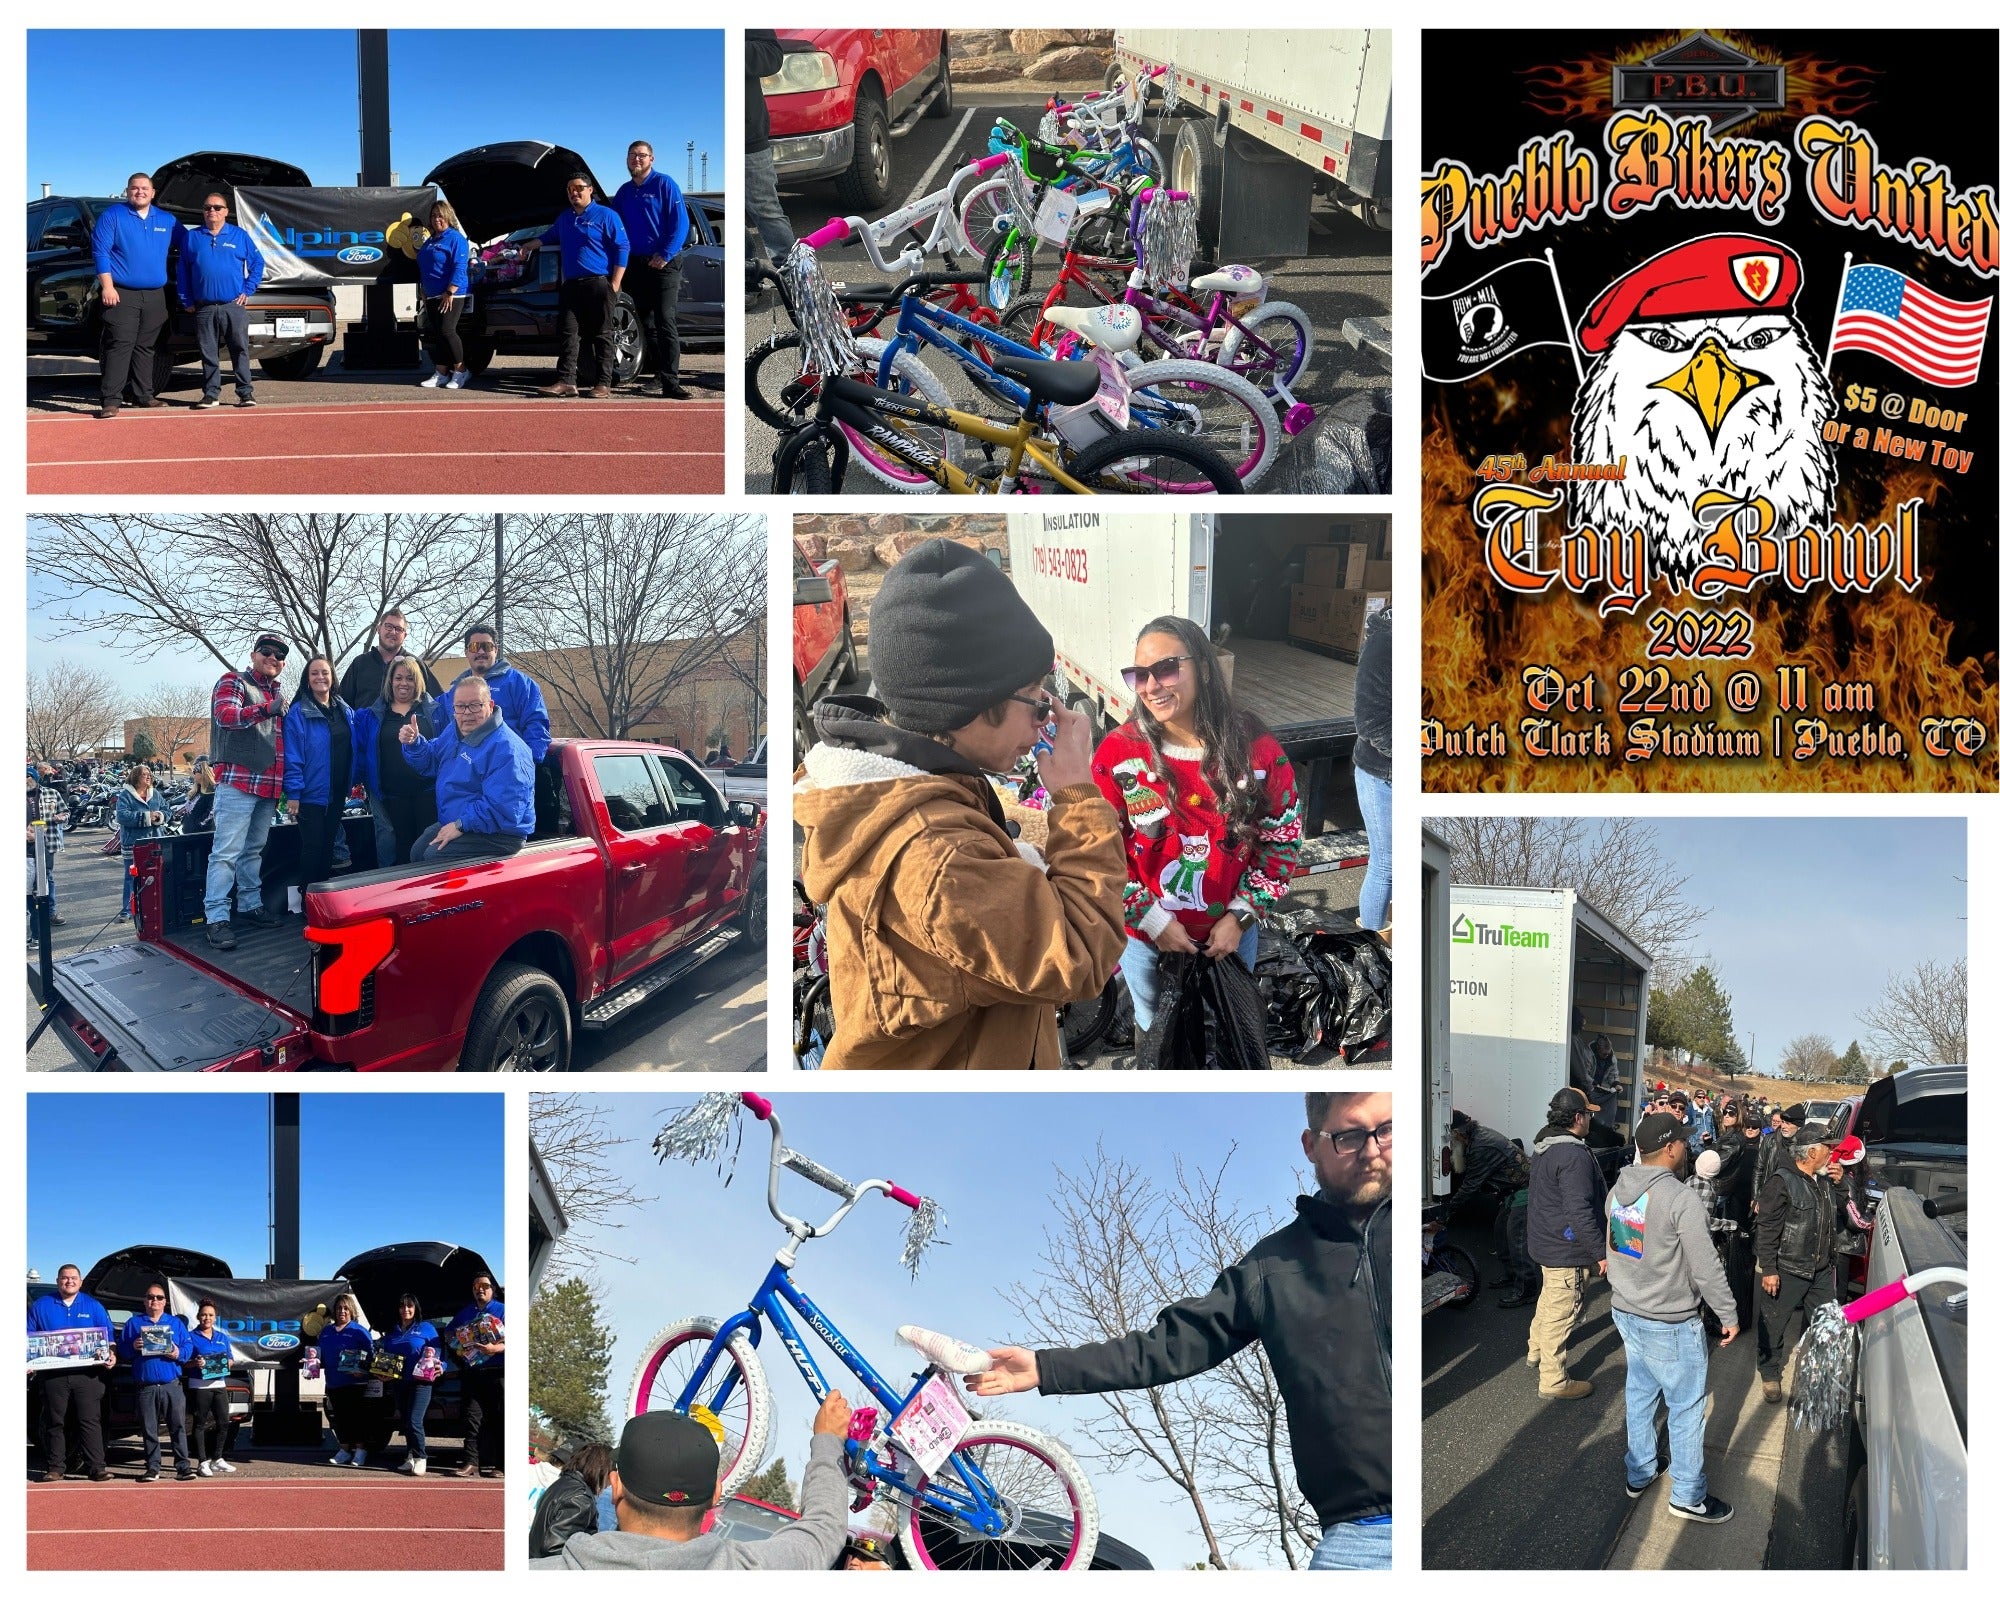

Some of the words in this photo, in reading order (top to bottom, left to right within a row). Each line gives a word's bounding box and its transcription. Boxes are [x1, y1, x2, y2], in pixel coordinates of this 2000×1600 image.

[1653, 74, 1756, 97] P.B.U.
[1608, 108, 1788, 223] Bikers
[1799, 120, 1999, 273] United
[254, 211, 384, 256] Alpine
[346, 249, 374, 262] Ford
[1452, 295, 1472, 327] POW
[1477, 284, 1502, 307] MIA
[952, 324, 999, 349] Seastar
[1457, 353, 1470, 363] YOU
[1468, 355, 1480, 363] ARE
[1479, 350, 1491, 361] NOT
[1490, 331, 1518, 357] FORGOTTEN
[939, 346, 1001, 384] HUFFY
[1843, 383, 1878, 413] $5
[1881, 393, 1905, 419] @
[1908, 398, 1968, 433] Door
[867, 424, 939, 466] RAMPAGE
[1823, 420, 1851, 444] or
[1853, 427, 1870, 449] a
[1873, 427, 1927, 461] New
[1931, 440, 1974, 474] Toy
[1476, 453, 1527, 482] 45th
[1528, 454, 1628, 483] Annual
[1043, 513, 1100, 531] INSULATION
[1047, 547, 1088, 584] 543-0823
[1474, 484, 1651, 616] Toy
[1692, 485, 1924, 600] Bowl
[1648, 610, 1753, 657] 2022
[1523, 666, 1602, 712] Oct.
[1619, 666, 1711, 712] 22nd
[1727, 672, 1760, 712] @
[1777, 666, 1807, 712] 11
[1824, 681, 1875, 712] am
[1421, 717, 1506, 757] Dutch
[1521, 717, 1611, 757] Clark
[1625, 716, 1761, 761] Stadium
[1794, 717, 1909, 760] Pueblo,
[1921, 717, 1987, 757] CO
[1475, 923, 1549, 948] TruTeam
[216, 1316, 300, 1337] lpine
[266, 1336, 292, 1348] Ford
[810, 1314, 849, 1356] Seastar
